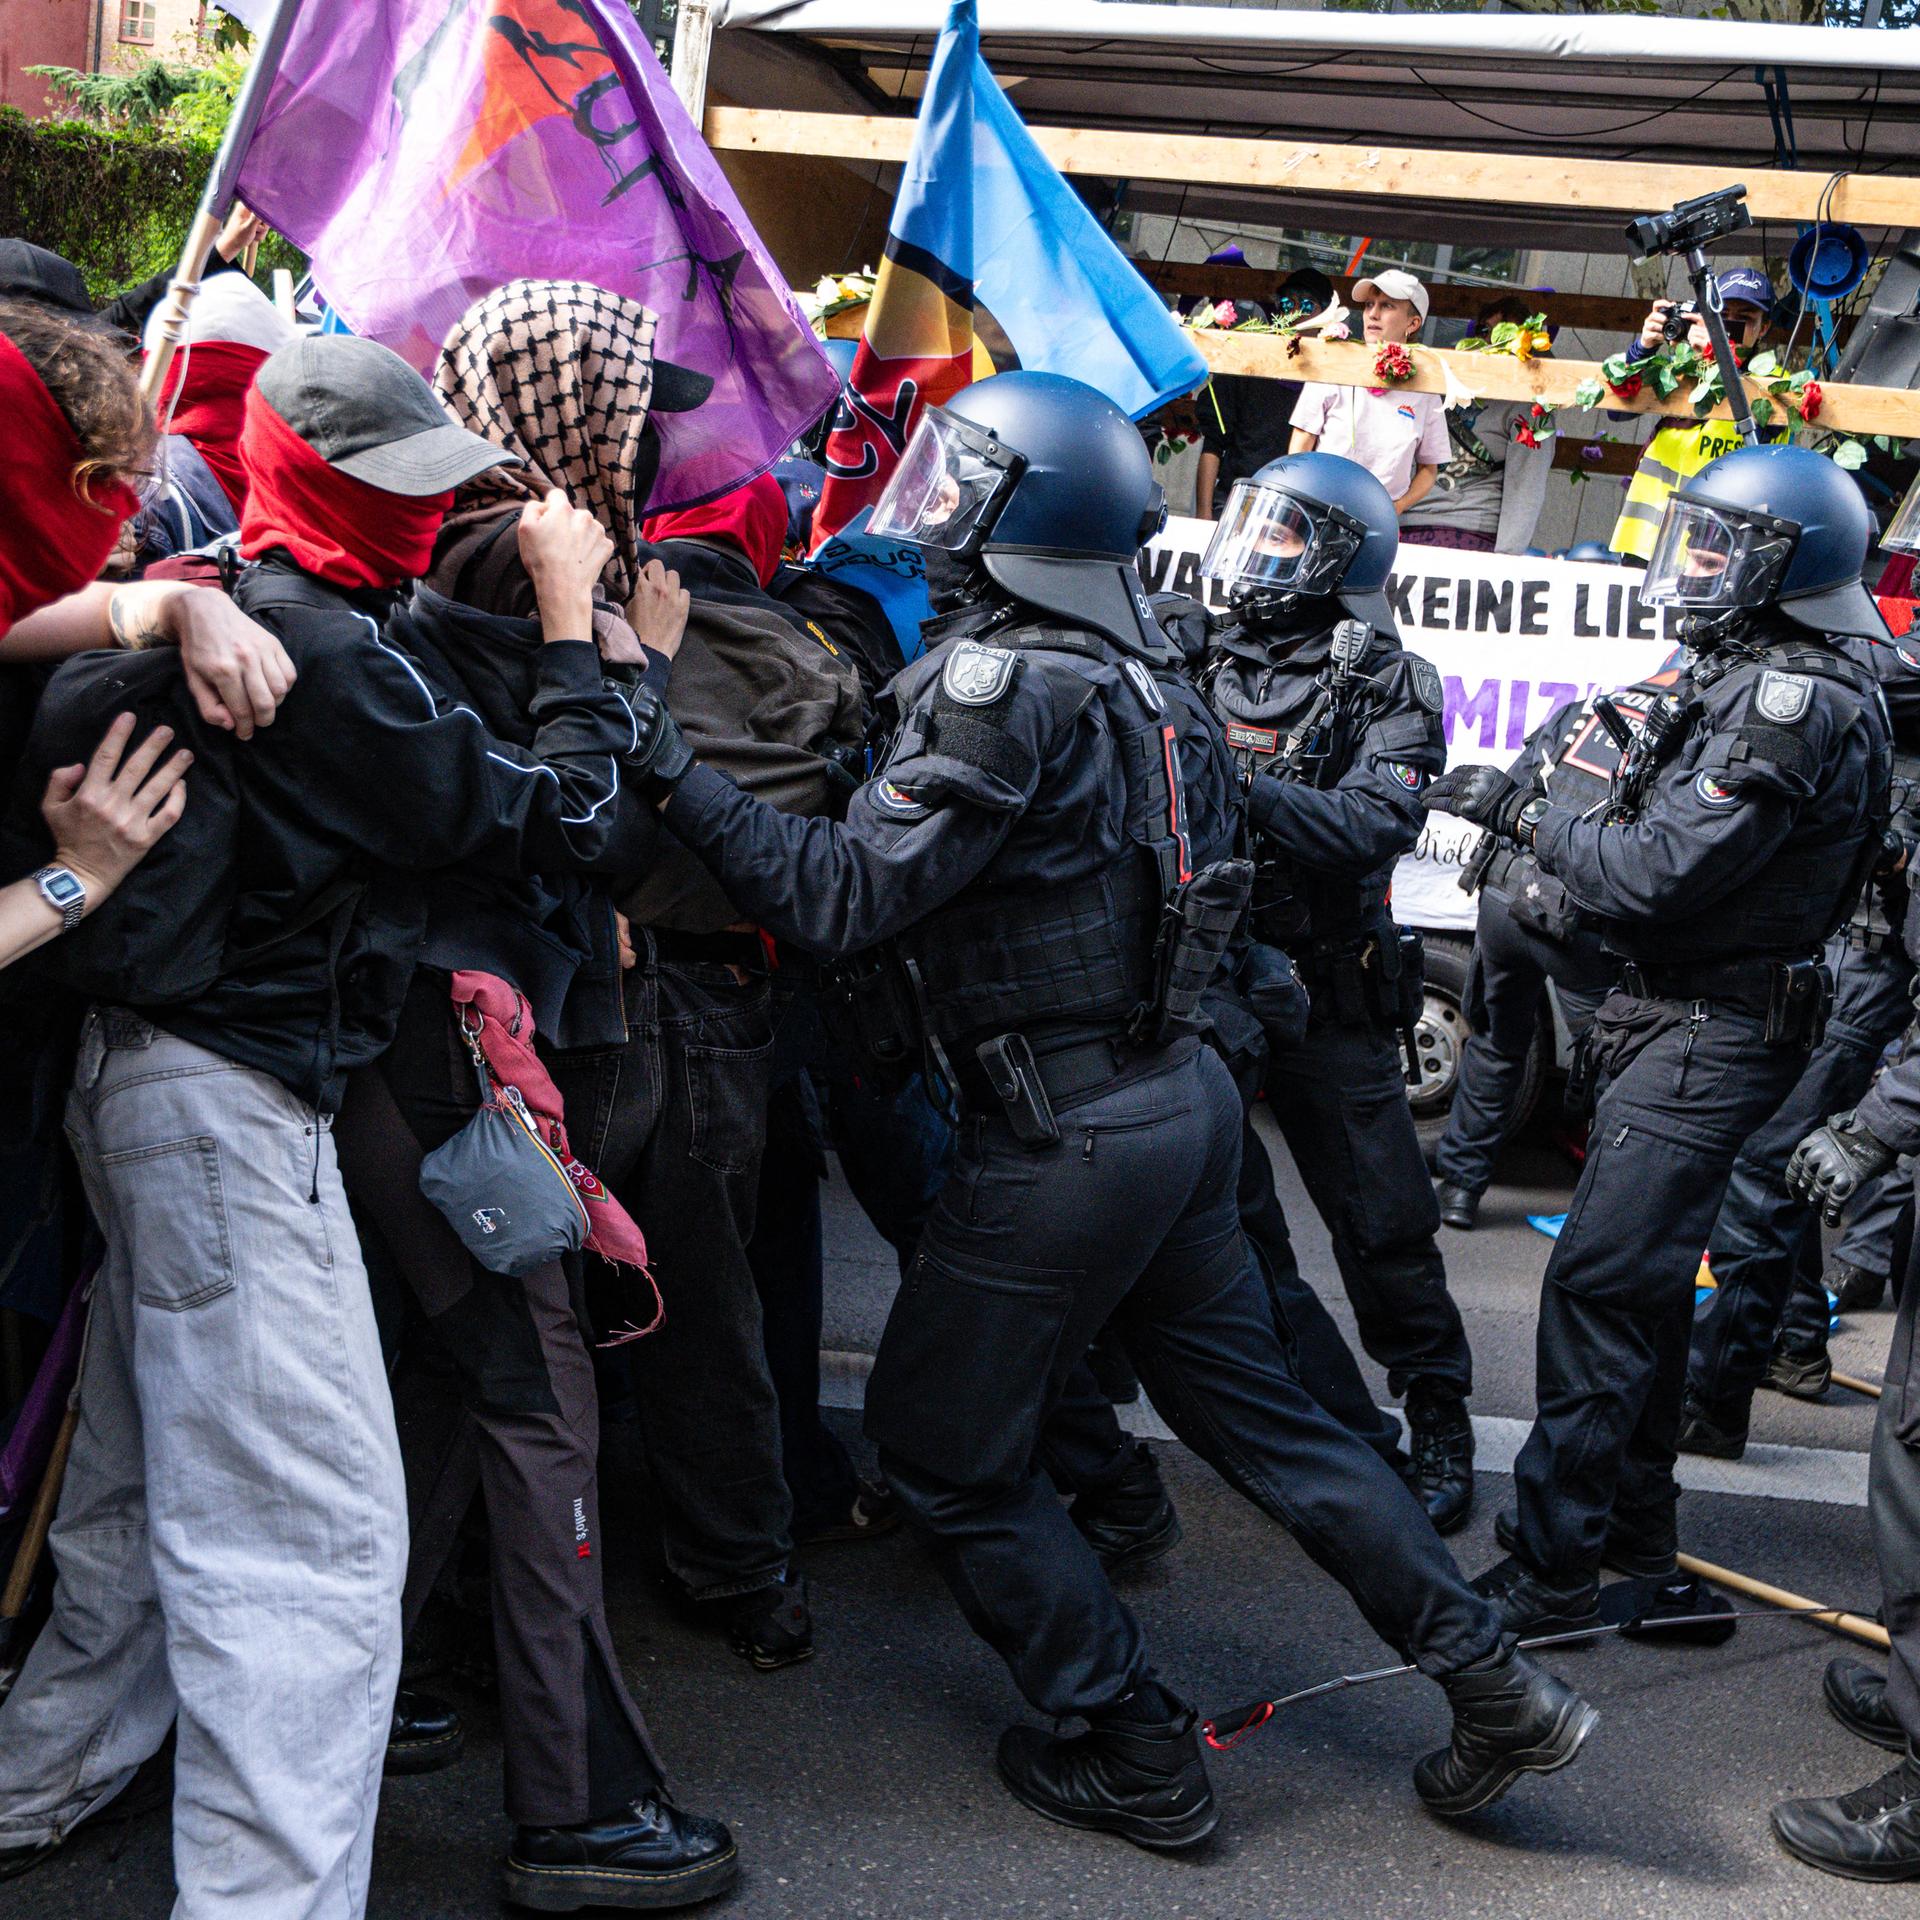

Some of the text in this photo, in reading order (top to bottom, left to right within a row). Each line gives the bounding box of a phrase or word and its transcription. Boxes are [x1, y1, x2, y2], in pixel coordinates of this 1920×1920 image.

[1384, 573, 1550, 635] KEINE
[959, 642, 1010, 660] POLIZEI
[1767, 672, 1809, 686] POLIZEI
[572, 1497, 589, 1541] mello's
